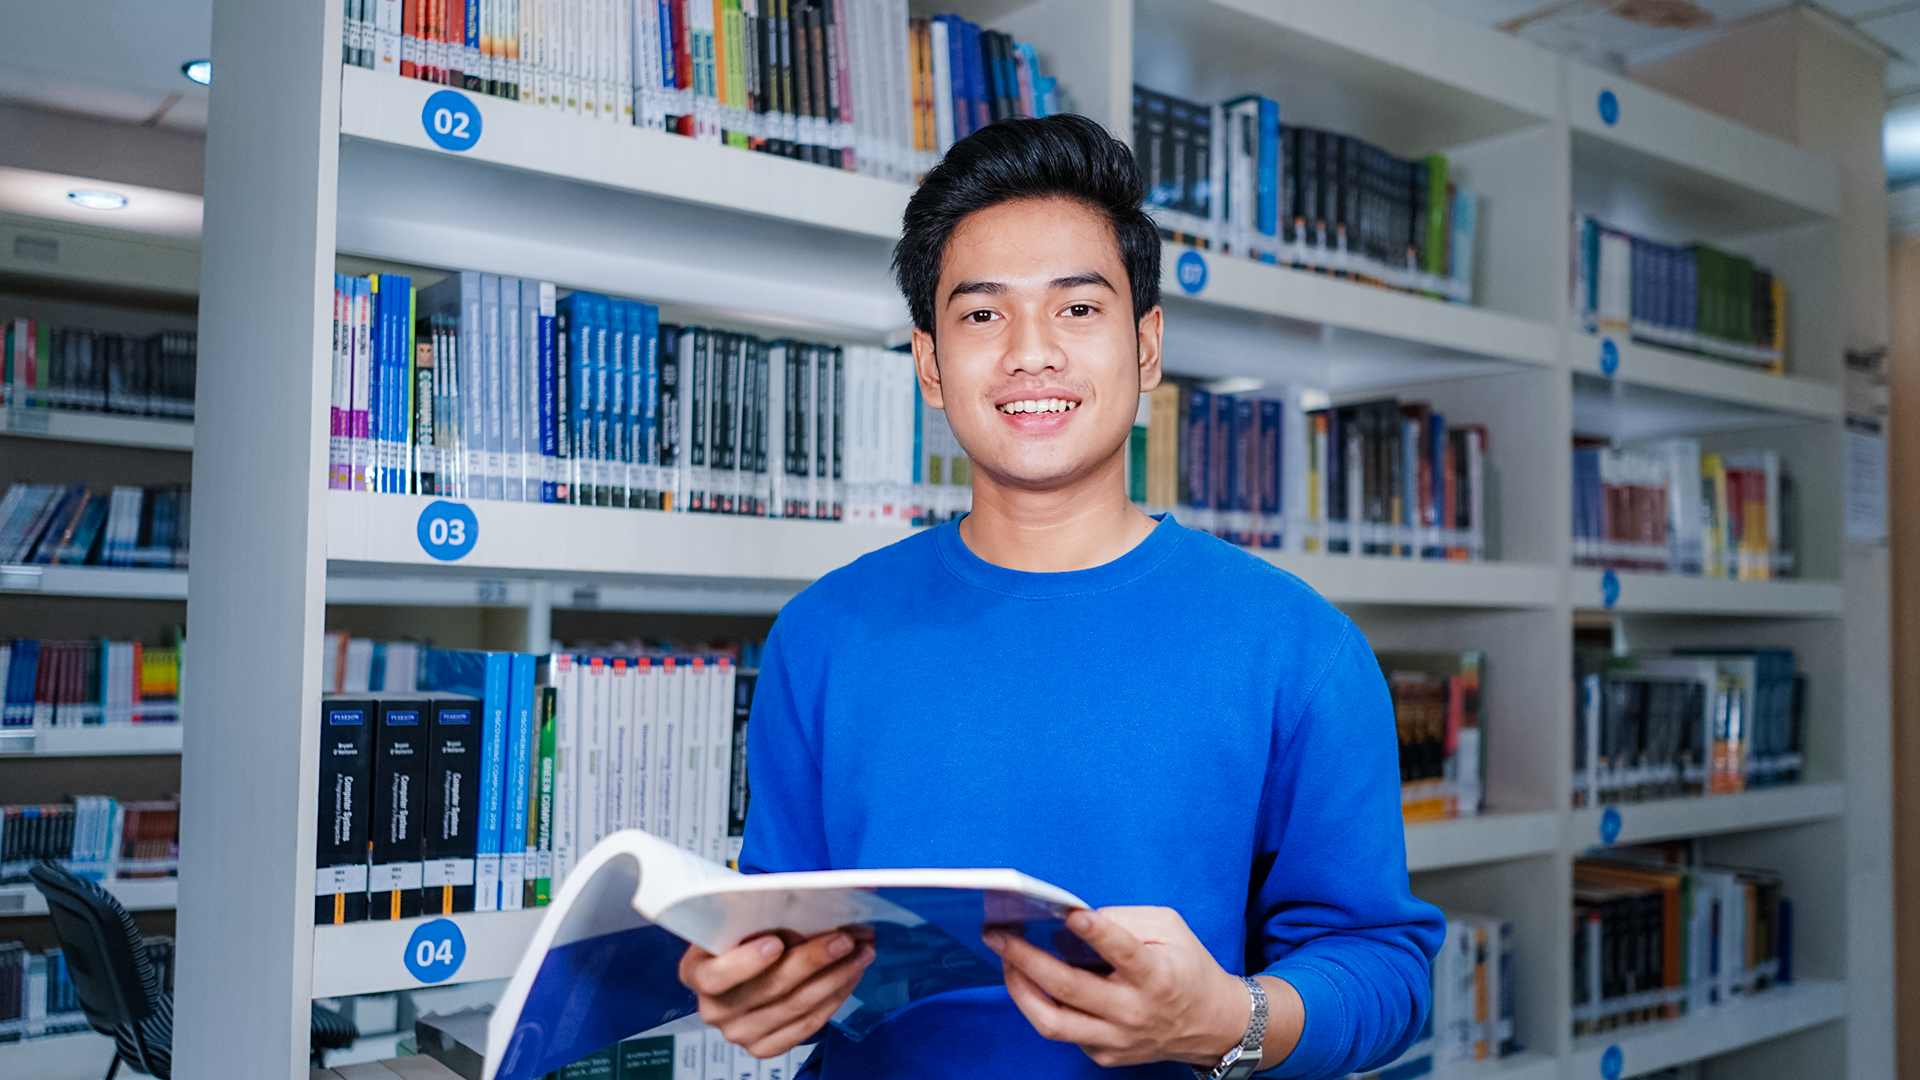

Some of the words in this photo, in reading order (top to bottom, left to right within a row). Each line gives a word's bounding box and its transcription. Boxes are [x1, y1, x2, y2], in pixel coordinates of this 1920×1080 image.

[434, 108, 470, 139] 02
[429, 519, 466, 545] 03
[493, 710, 501, 762] DISCOVERING
[518, 710, 527, 762] DISCOVERING
[451, 773, 461, 806] Computer
[489, 764, 500, 811] COMPUTERS
[515, 764, 526, 811] COMPUTERS
[542, 758, 552, 792] GREEN
[342, 776, 353, 810] Computer
[399, 775, 409, 809] Computer
[342, 812, 352, 841] Systems
[398, 810, 408, 840] Systems
[450, 807, 460, 836] Systems
[416, 939, 454, 967] 04
